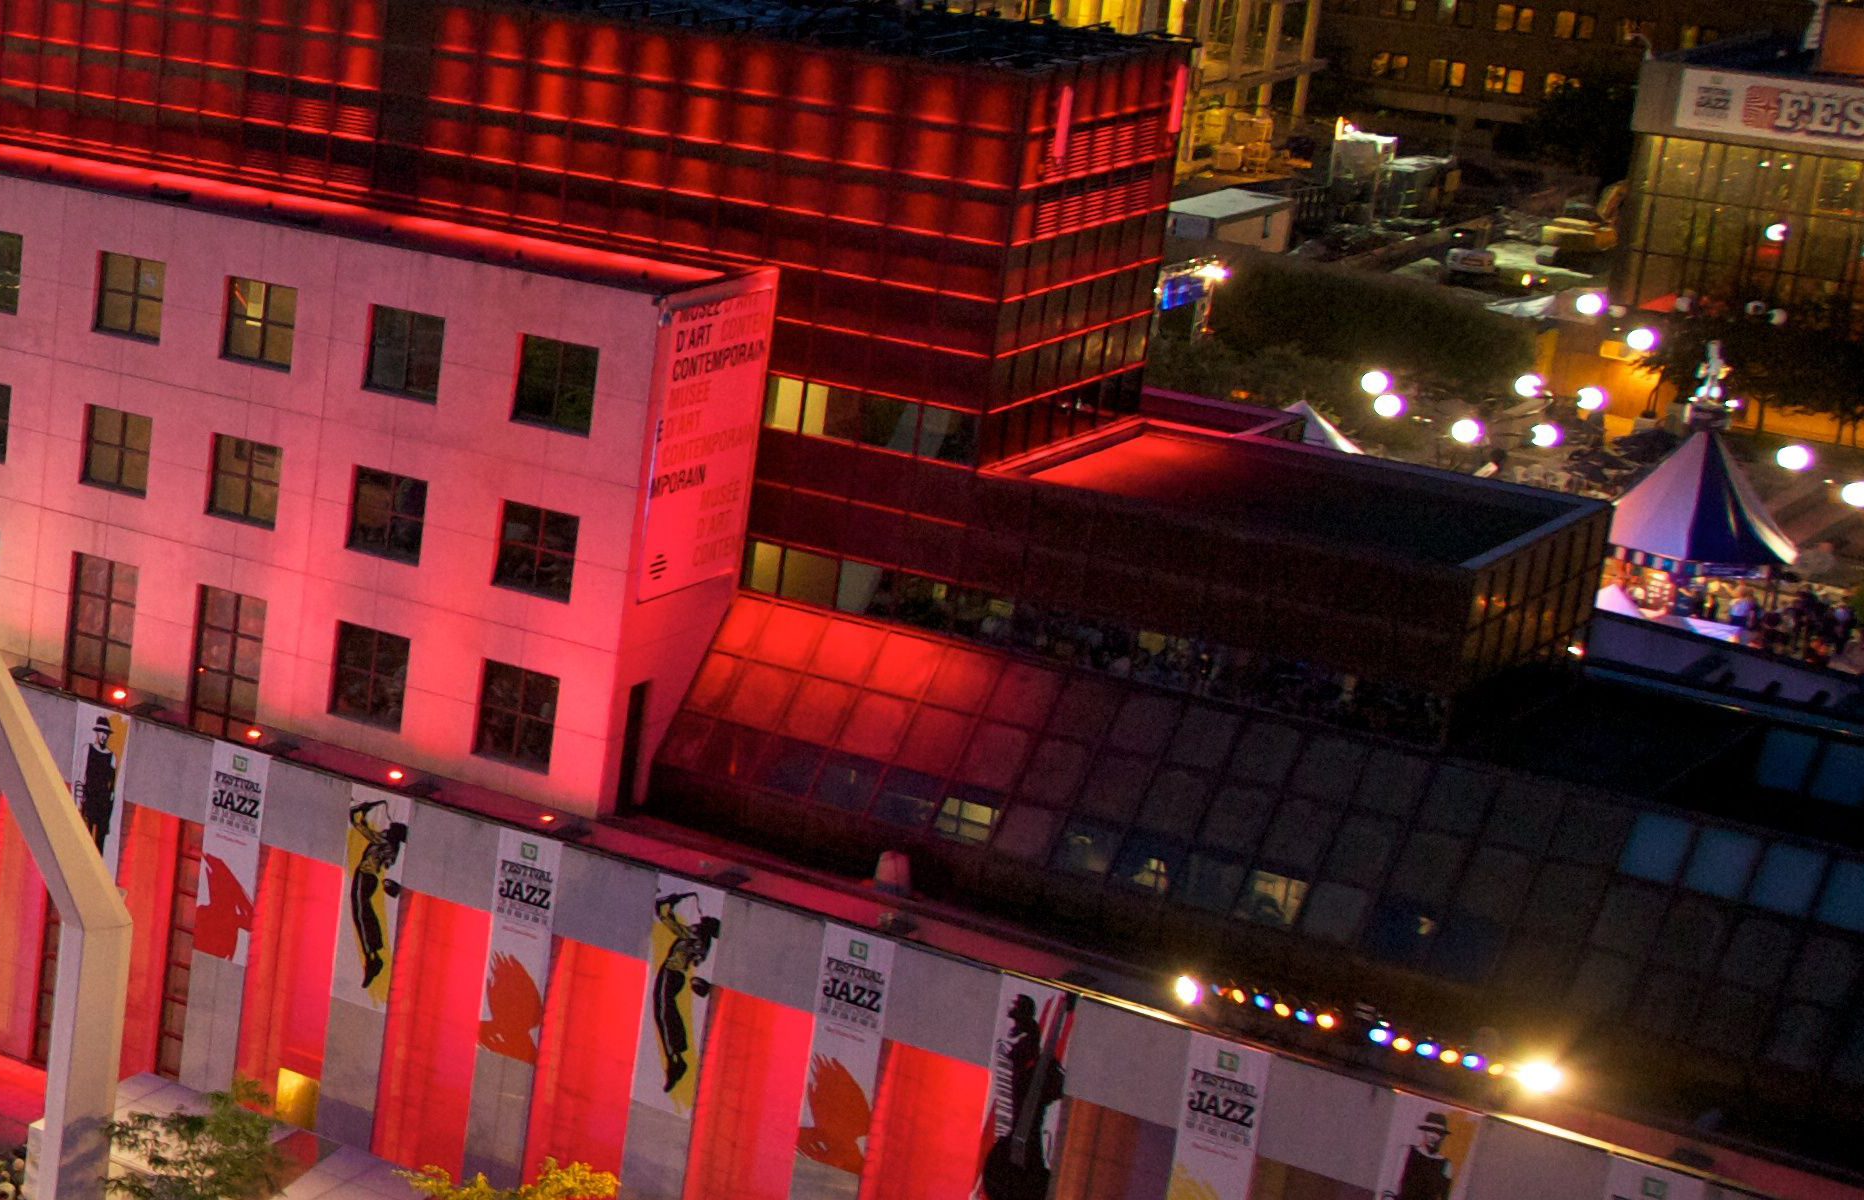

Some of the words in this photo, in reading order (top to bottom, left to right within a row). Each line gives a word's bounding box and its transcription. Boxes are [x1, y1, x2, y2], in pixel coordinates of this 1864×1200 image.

[676, 323, 712, 353] D'ART
[212, 789, 260, 819] JAZZ
[502, 860, 553, 883] FESTIVAL
[499, 879, 551, 910] JAZZ
[823, 977, 881, 1013] JAZZ
[1188, 1090, 1255, 1128] JAZZ
